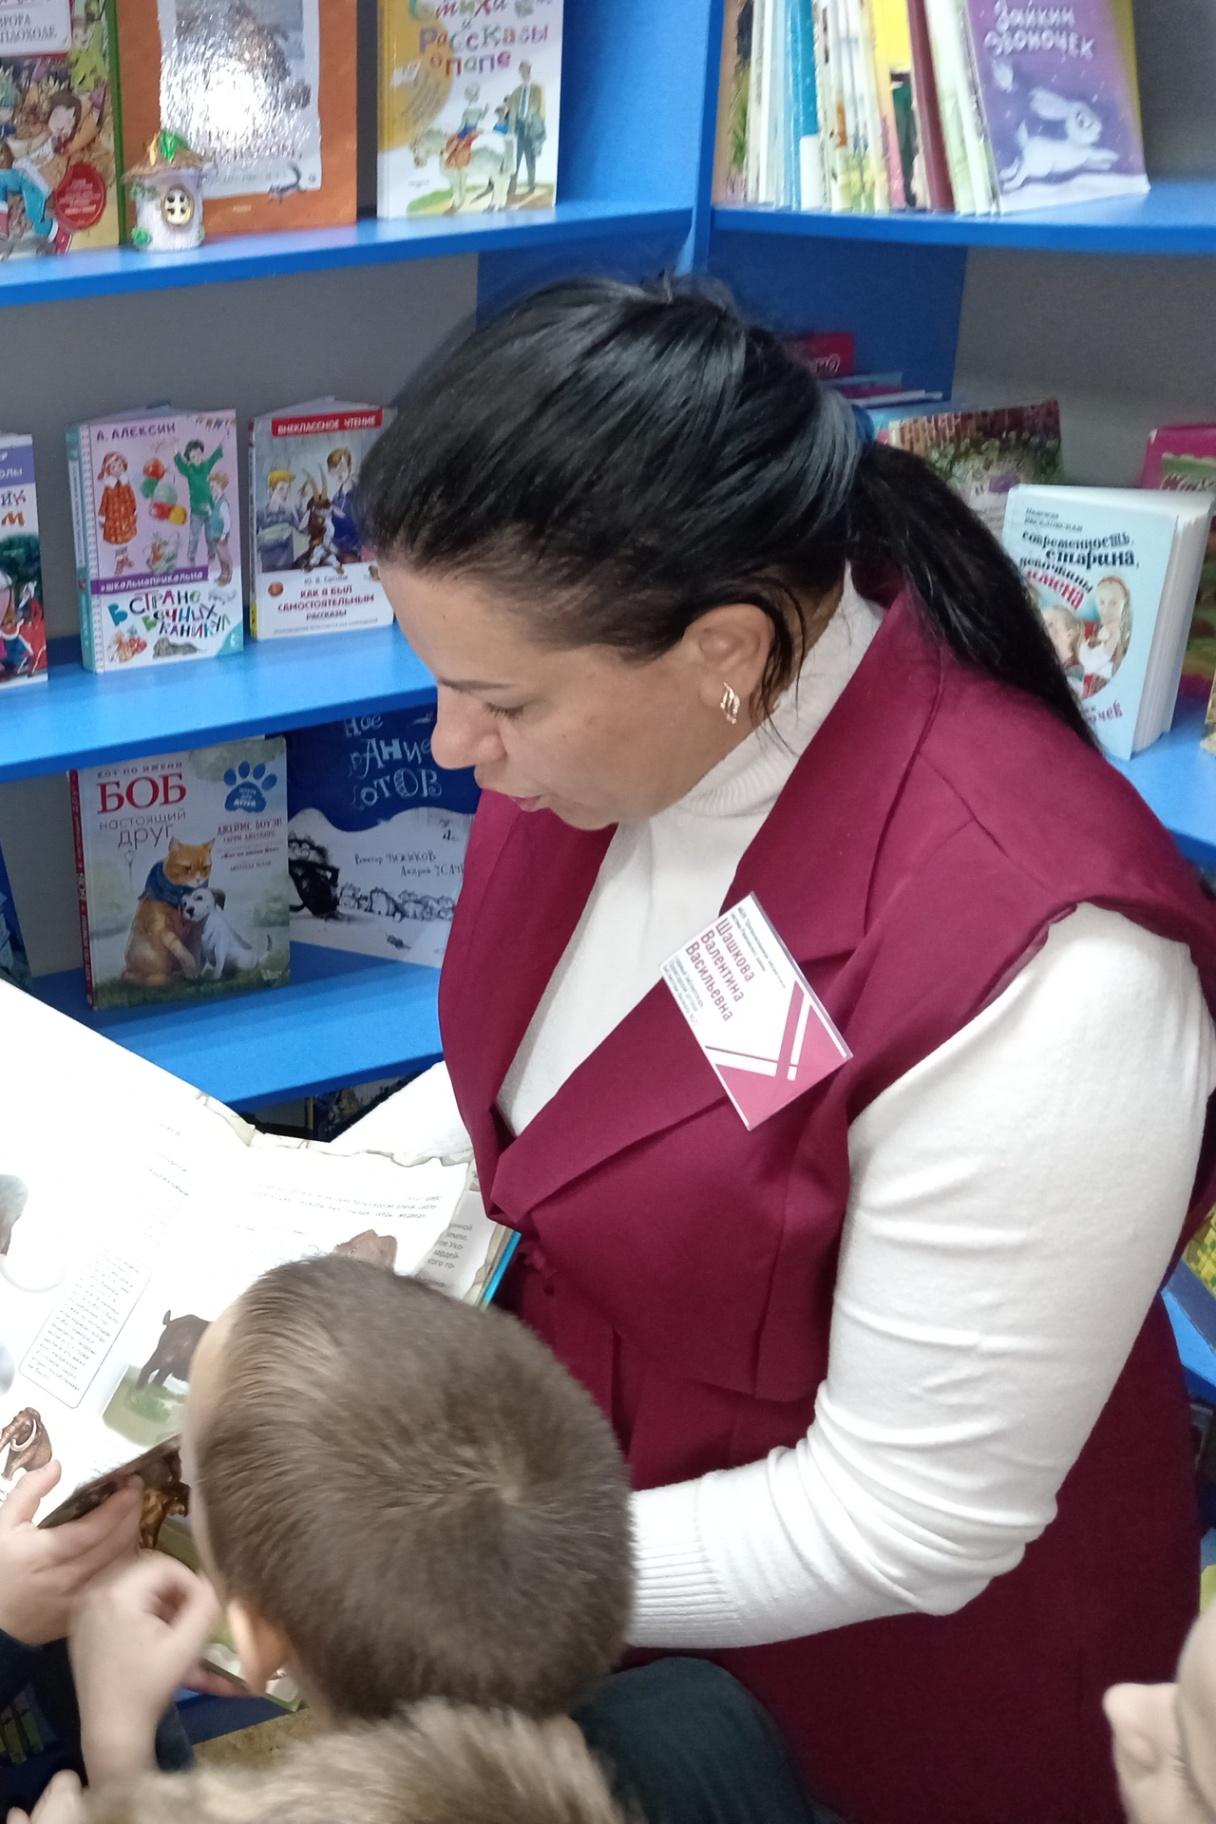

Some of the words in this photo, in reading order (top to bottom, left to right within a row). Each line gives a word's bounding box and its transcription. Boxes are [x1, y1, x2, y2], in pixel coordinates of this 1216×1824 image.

[111, 422, 176, 440] АЛЕКСИН
[277, 418, 340, 435] ВНЕКЛАССНОЕ
[344, 415, 377, 428] ЧТЕНИЕ
[108, 603, 128, 627] В
[97, 773, 188, 814] БОБ
[99, 808, 187, 832] настоящий
[117, 822, 175, 850] друг
[715, 917, 756, 982] Шашкова
[700, 929, 745, 1002] Валентина
[685, 941, 734, 1022] Васильевна
